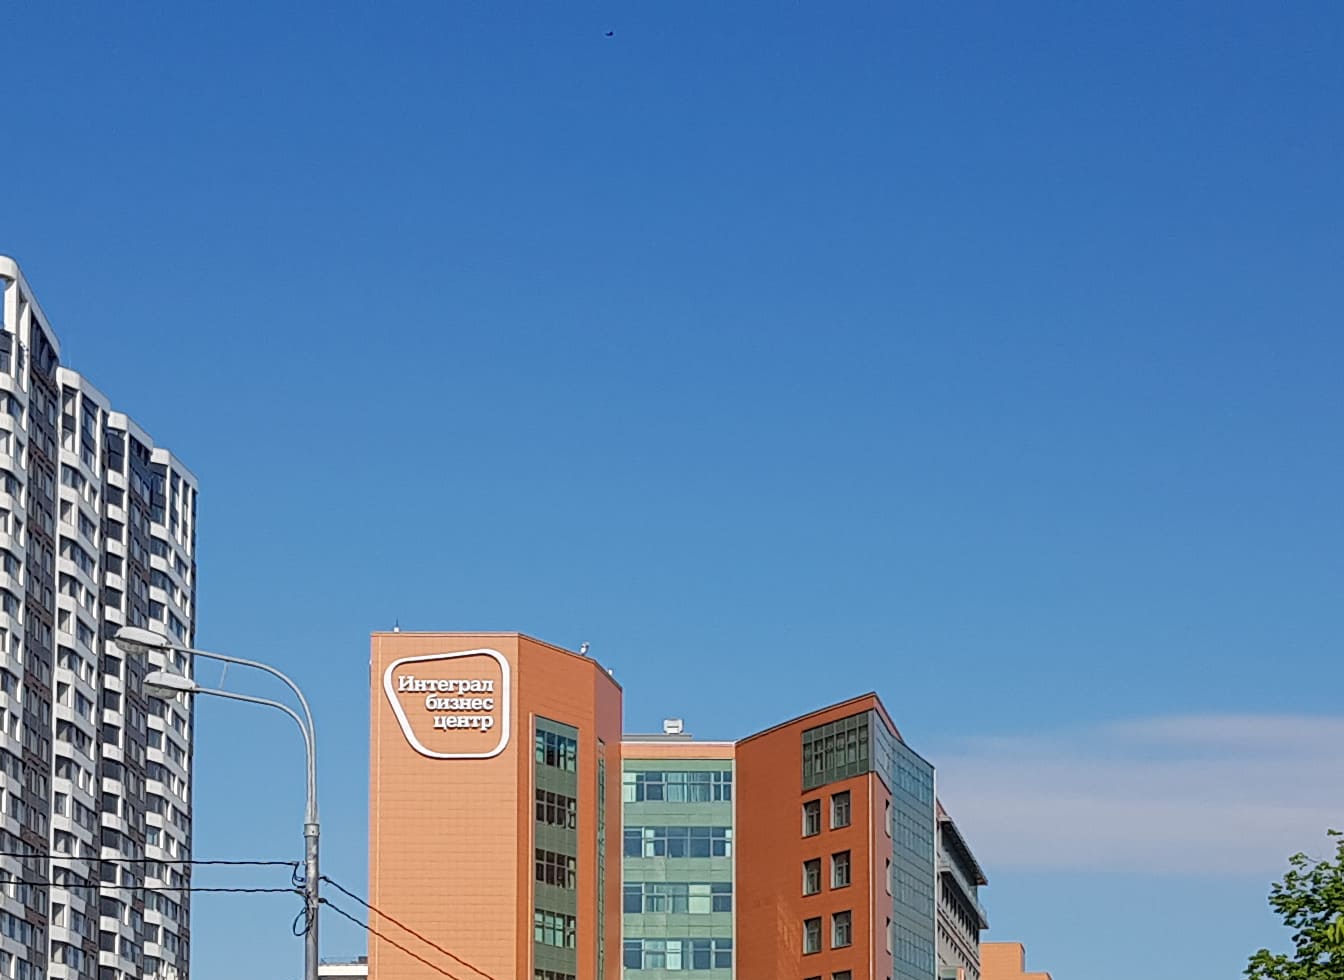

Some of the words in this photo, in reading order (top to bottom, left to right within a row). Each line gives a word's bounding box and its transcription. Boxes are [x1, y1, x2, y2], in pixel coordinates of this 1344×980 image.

[398, 676, 494, 695] Интеграл
[425, 694, 494, 710] бизнес
[433, 715, 494, 732] центр
